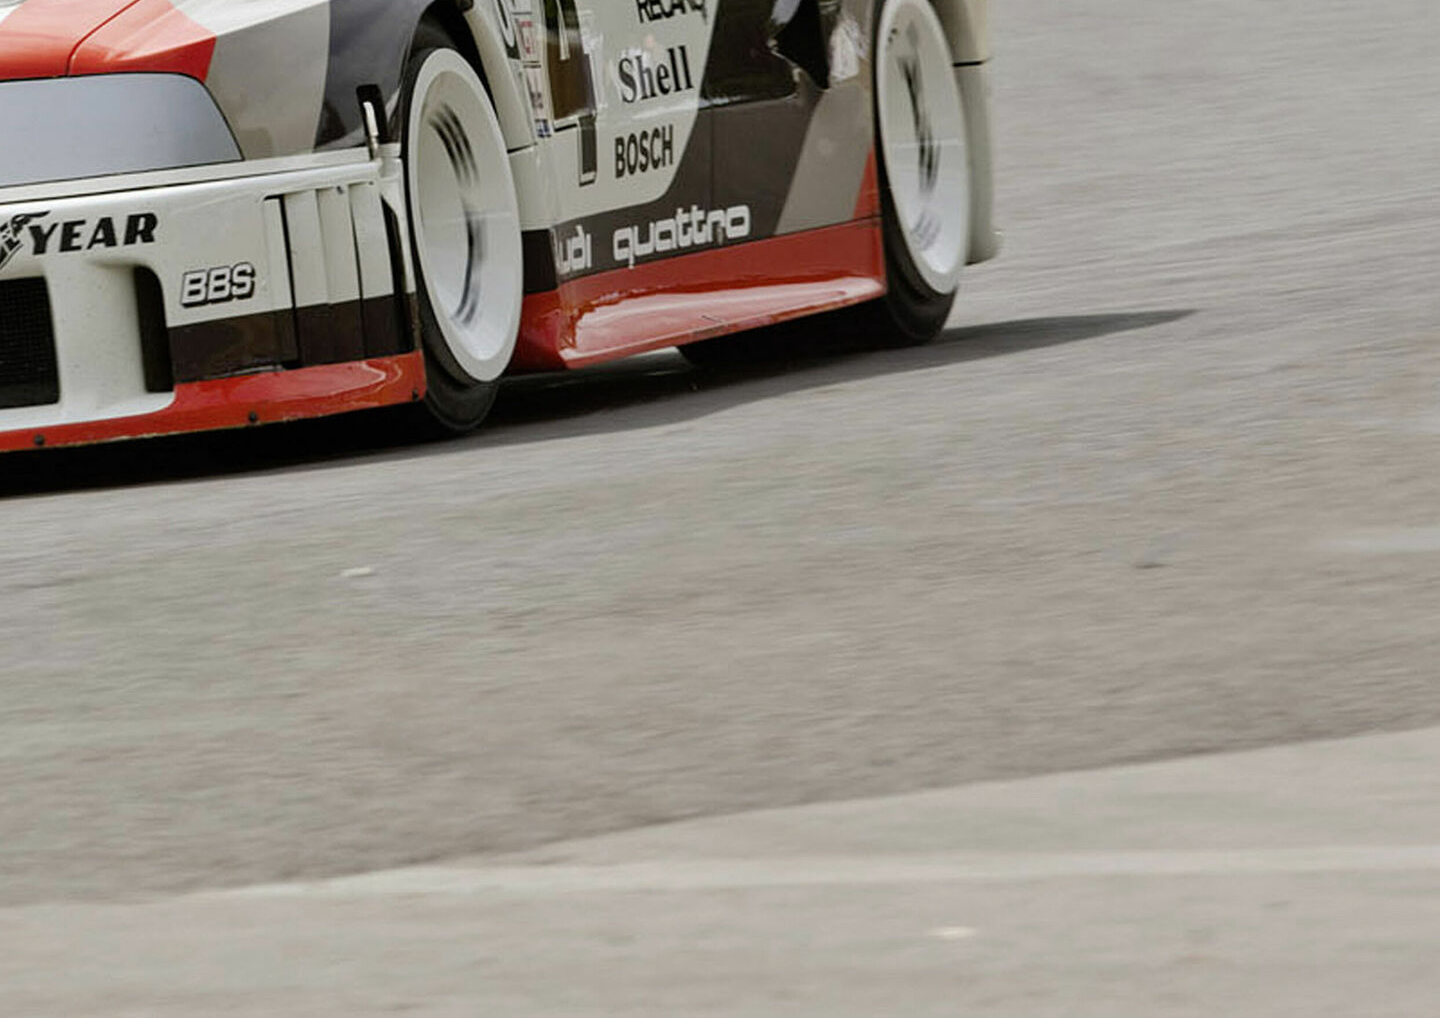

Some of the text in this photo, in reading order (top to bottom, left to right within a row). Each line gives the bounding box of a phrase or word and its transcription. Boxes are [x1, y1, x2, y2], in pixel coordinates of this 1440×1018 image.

[618, 45, 694, 103] Shell
[615, 124, 674, 178] BOSCH
[555, 204, 751, 275] udi quattro
[180, 262, 256, 309] BBS
